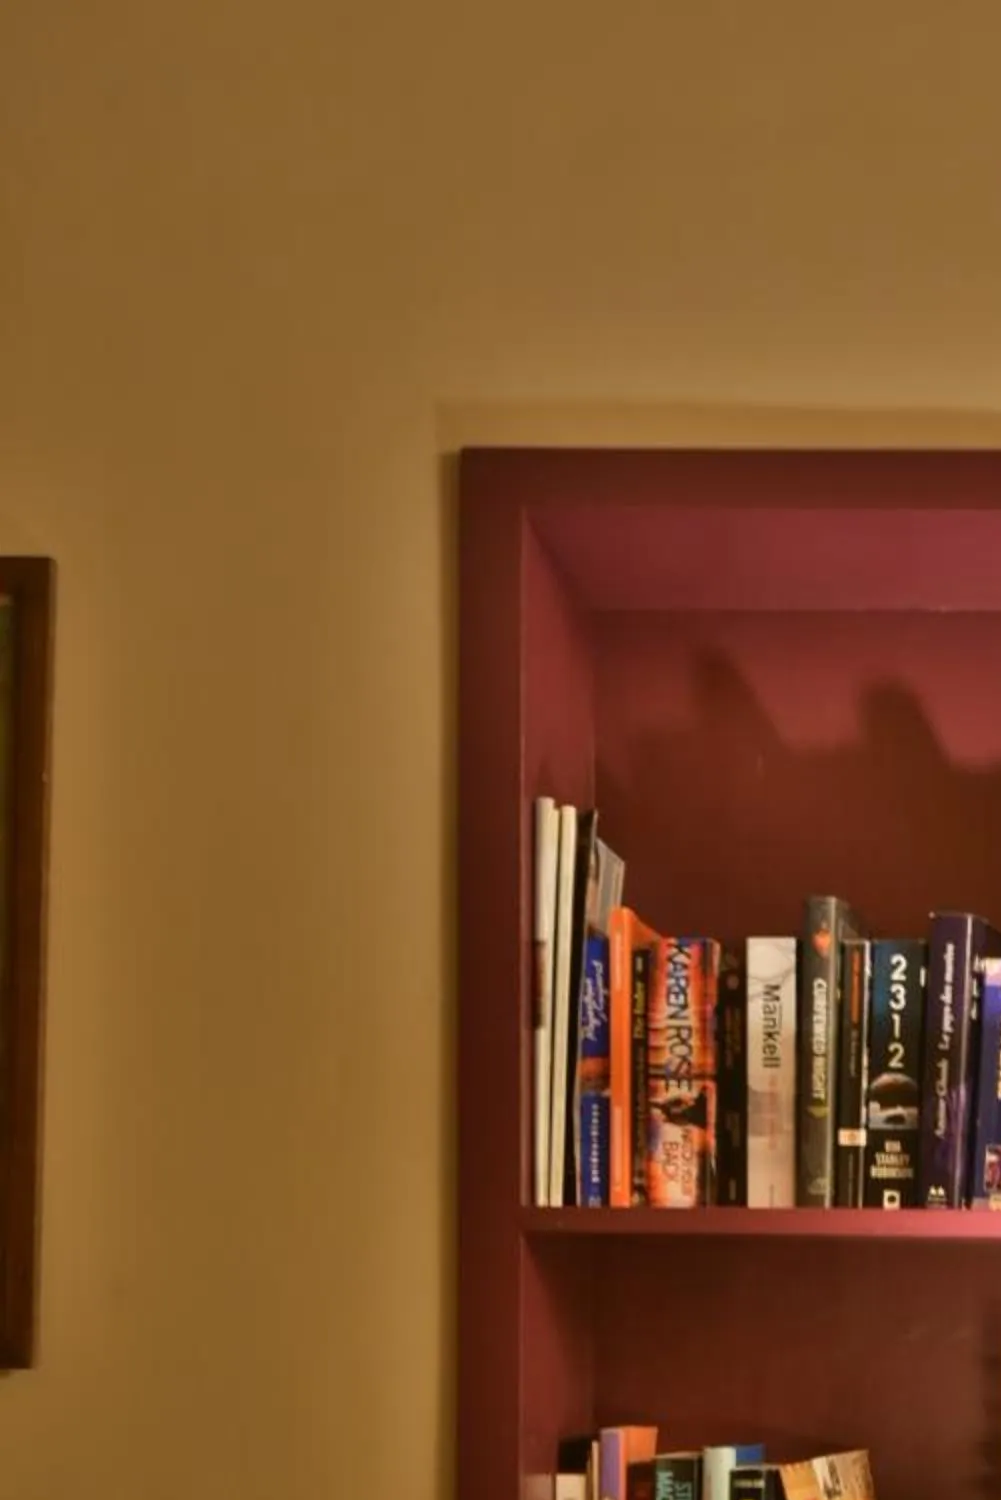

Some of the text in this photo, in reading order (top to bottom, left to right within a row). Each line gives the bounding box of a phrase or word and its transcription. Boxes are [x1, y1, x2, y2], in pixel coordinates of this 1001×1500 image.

[664, 942, 694, 1094] KAREN ROSE
[762, 983, 782, 1069] Mankell
